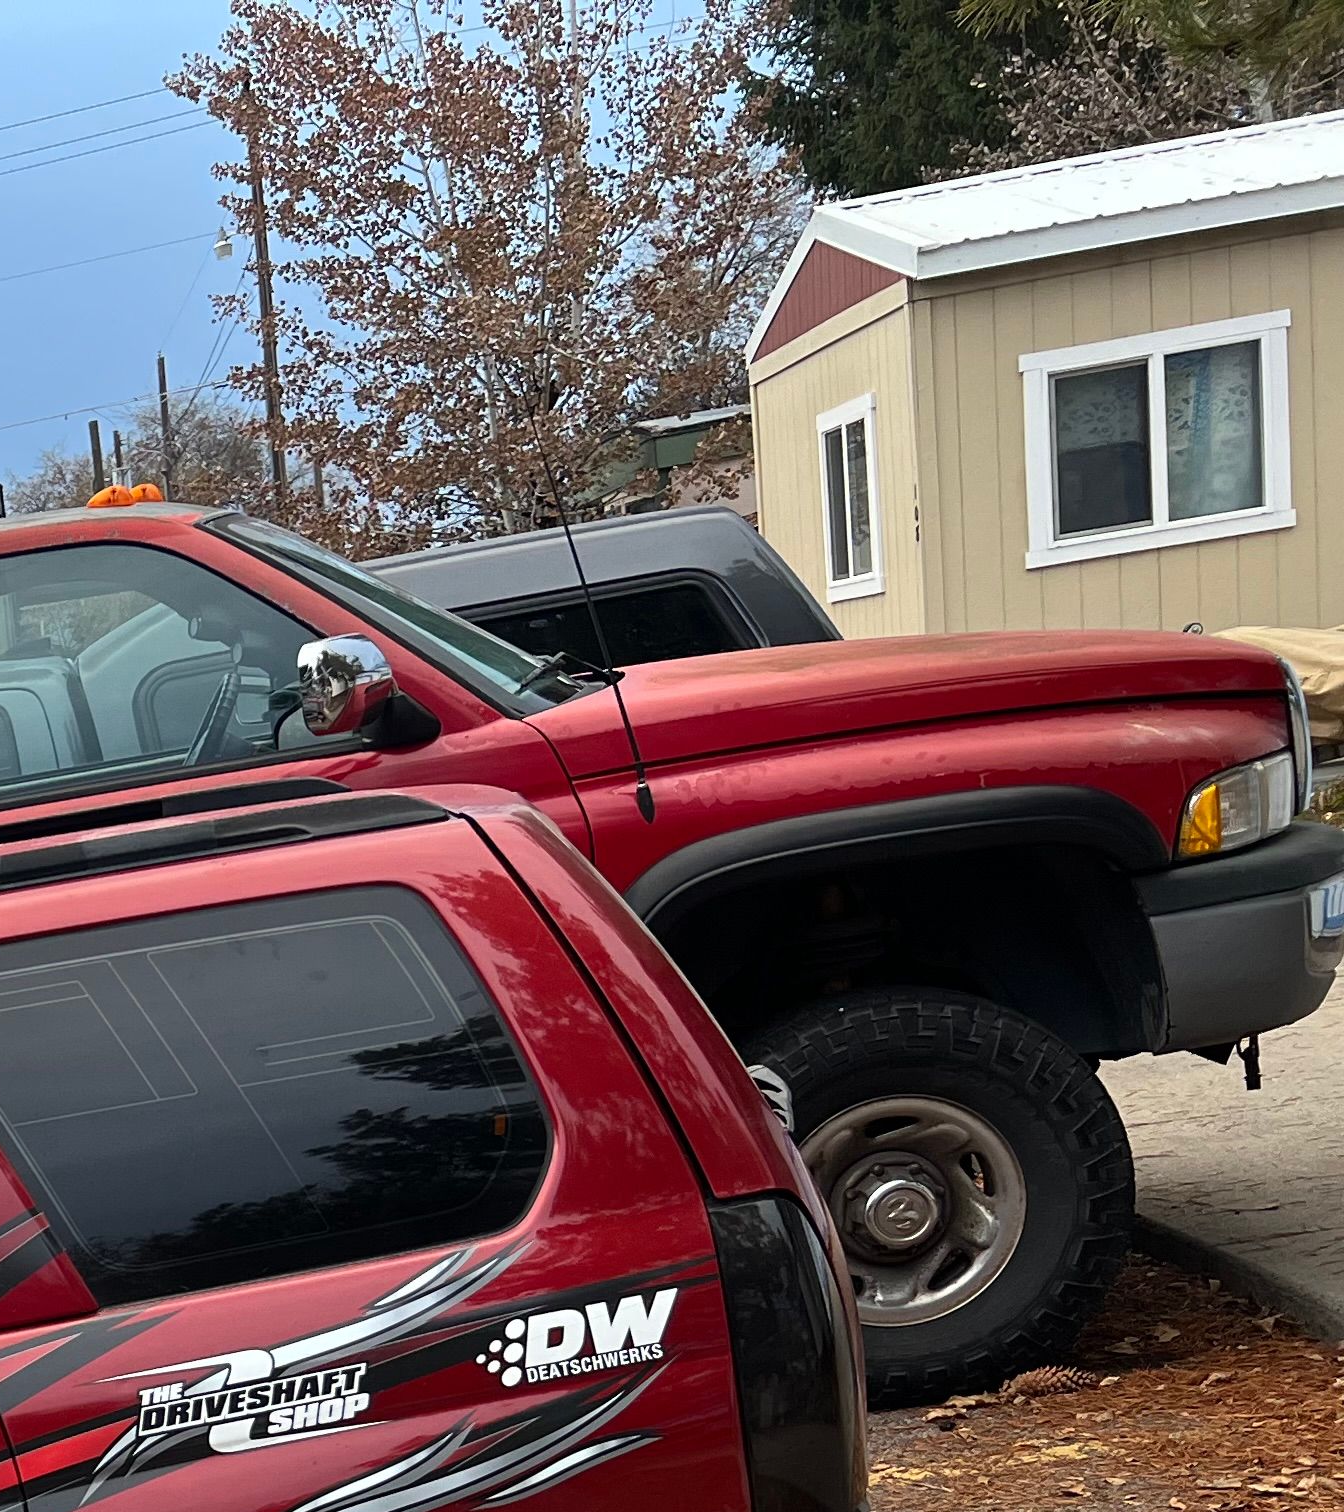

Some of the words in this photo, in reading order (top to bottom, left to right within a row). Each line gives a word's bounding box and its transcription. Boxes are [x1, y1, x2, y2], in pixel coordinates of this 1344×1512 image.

[525, 1287, 679, 1369] DW
[525, 1343, 664, 1384] DEATSCHWERKS
[137, 1362, 368, 1437] DRIVESHAFT
[138, 1380, 184, 1402] THE
[267, 1392, 371, 1436] SHOP
